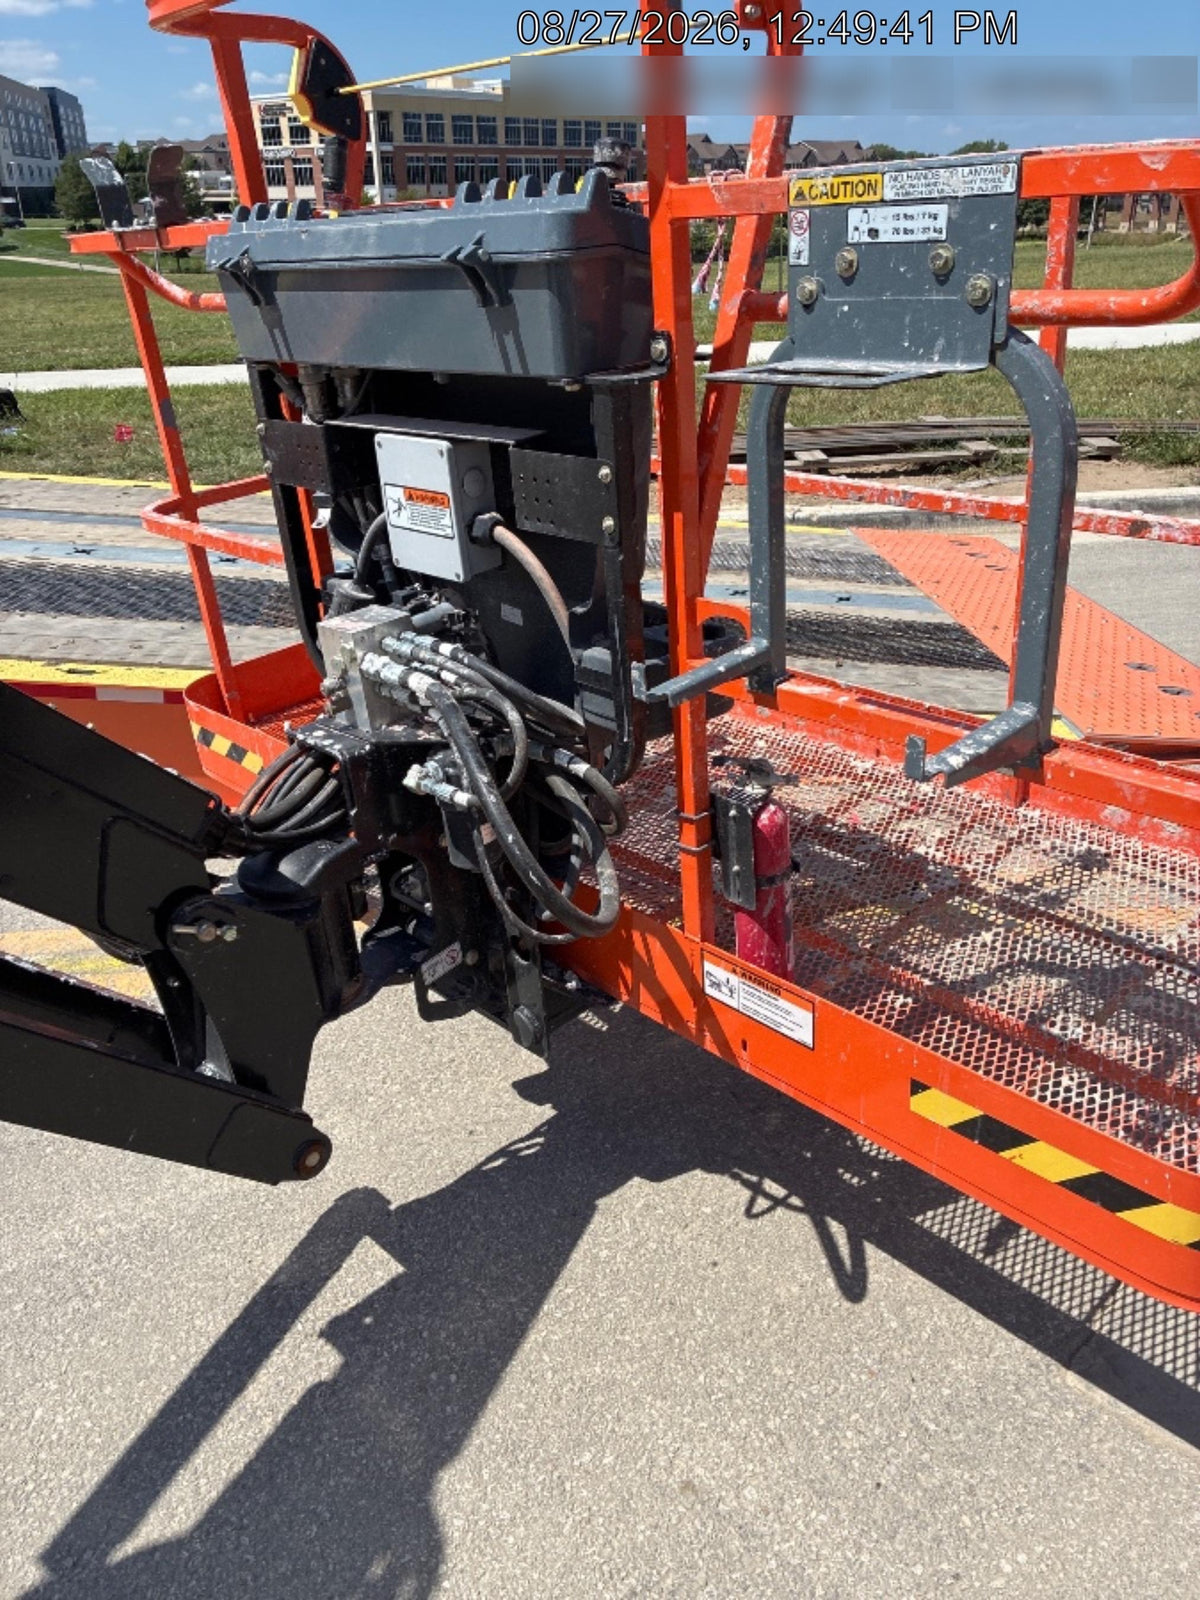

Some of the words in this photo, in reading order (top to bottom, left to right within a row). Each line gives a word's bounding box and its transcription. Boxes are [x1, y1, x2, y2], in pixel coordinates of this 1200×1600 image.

[808, 179, 878, 200] CAUTION
[903, 212, 915, 221] lbs
[903, 226, 915, 236] lbs
